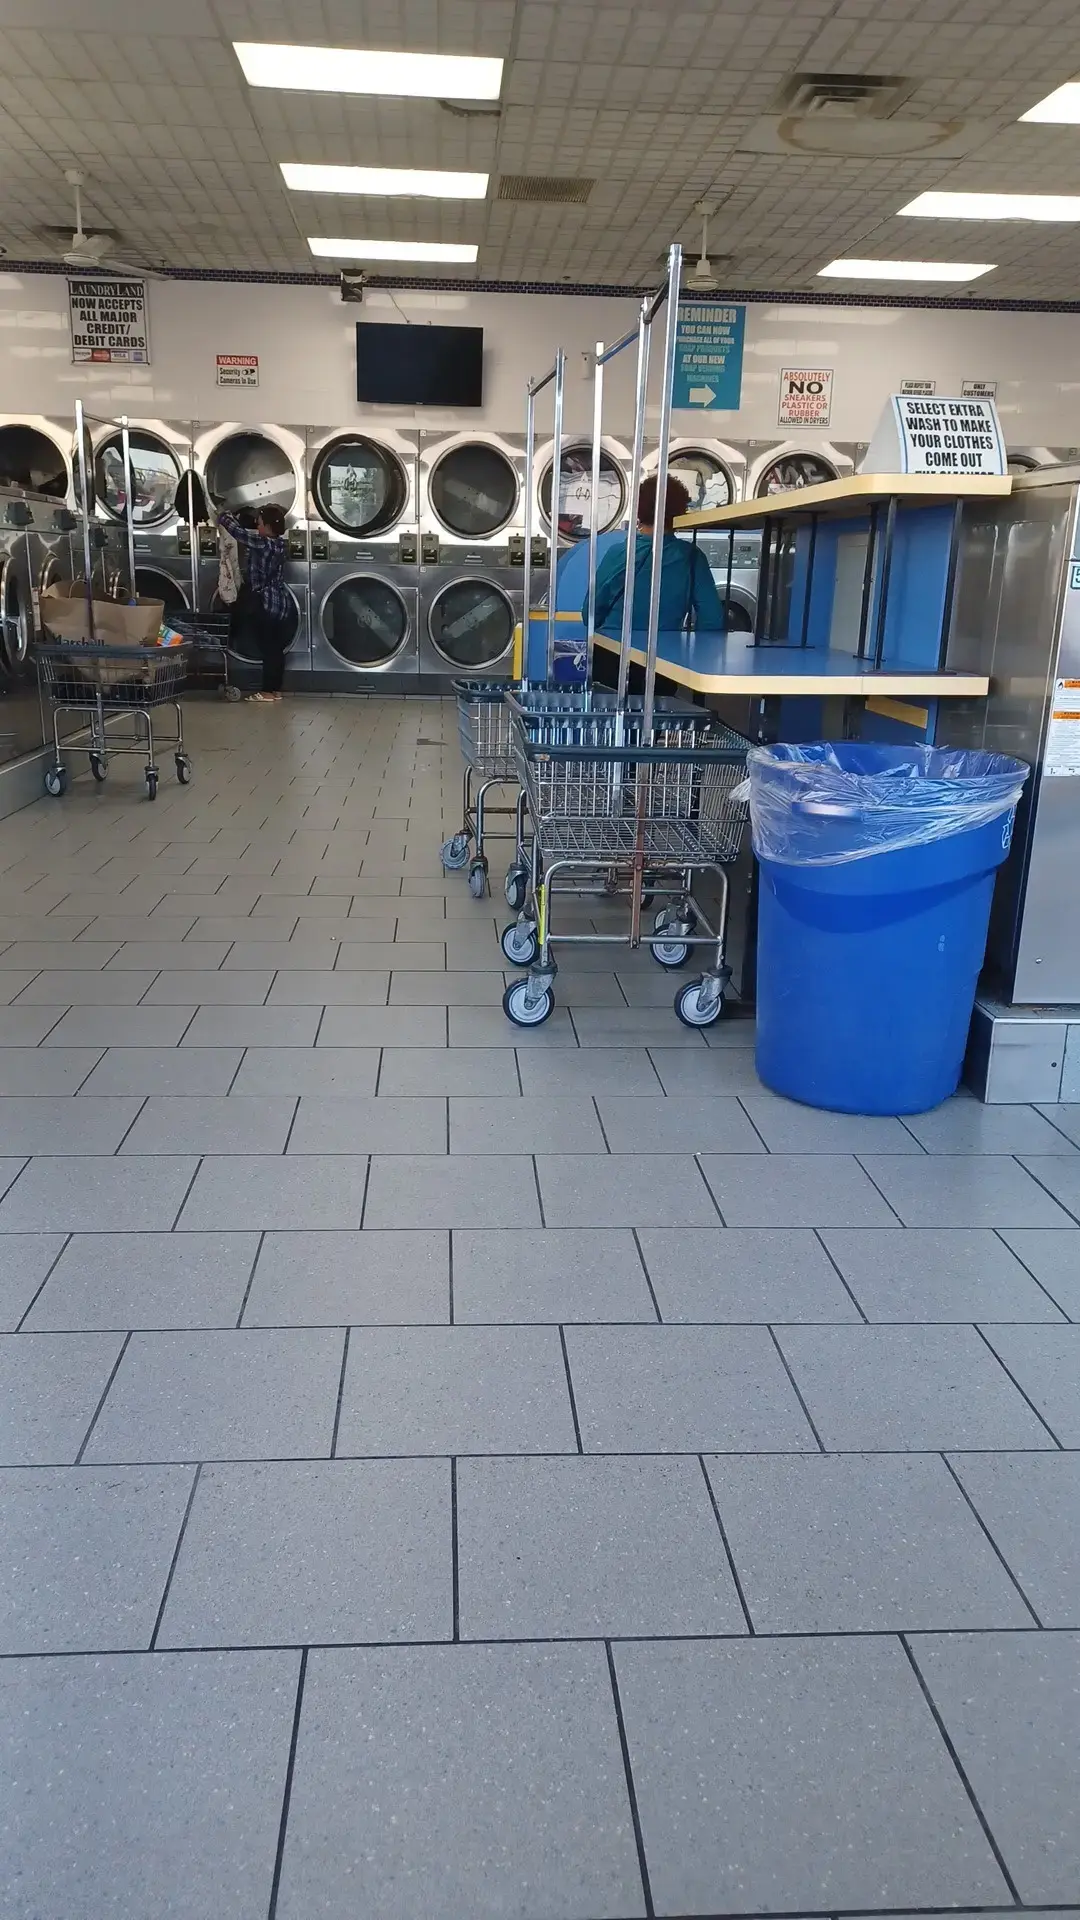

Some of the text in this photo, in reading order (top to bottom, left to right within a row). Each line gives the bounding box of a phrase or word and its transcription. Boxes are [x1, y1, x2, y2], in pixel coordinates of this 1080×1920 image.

[72, 298, 143, 310] NOW ACCEPTS
[80, 311, 137, 322] ALL MAJOR
[86, 323, 131, 335] CREDIT/
[681, 325, 731, 335] YOU CAN NOW
[74, 335, 145, 347] DEBIT CARDS
[219, 357, 257, 365] WARNING
[692, 355, 708, 363] OUR
[708, 355, 725, 364] NEW
[219, 367, 240, 376] Security
[784, 372, 831, 381] ABSOLUTELY
[220, 376, 241, 384] Cameras
[789, 381, 823, 394] NO
[816, 402, 828, 410] OR
[906, 402, 985, 417] SELECT EXTRA
[905, 417, 992, 433] WASH TO MAKE
[910, 433, 994, 450] YOUR CLOTHES
[925, 451, 982, 467] COME OUT
